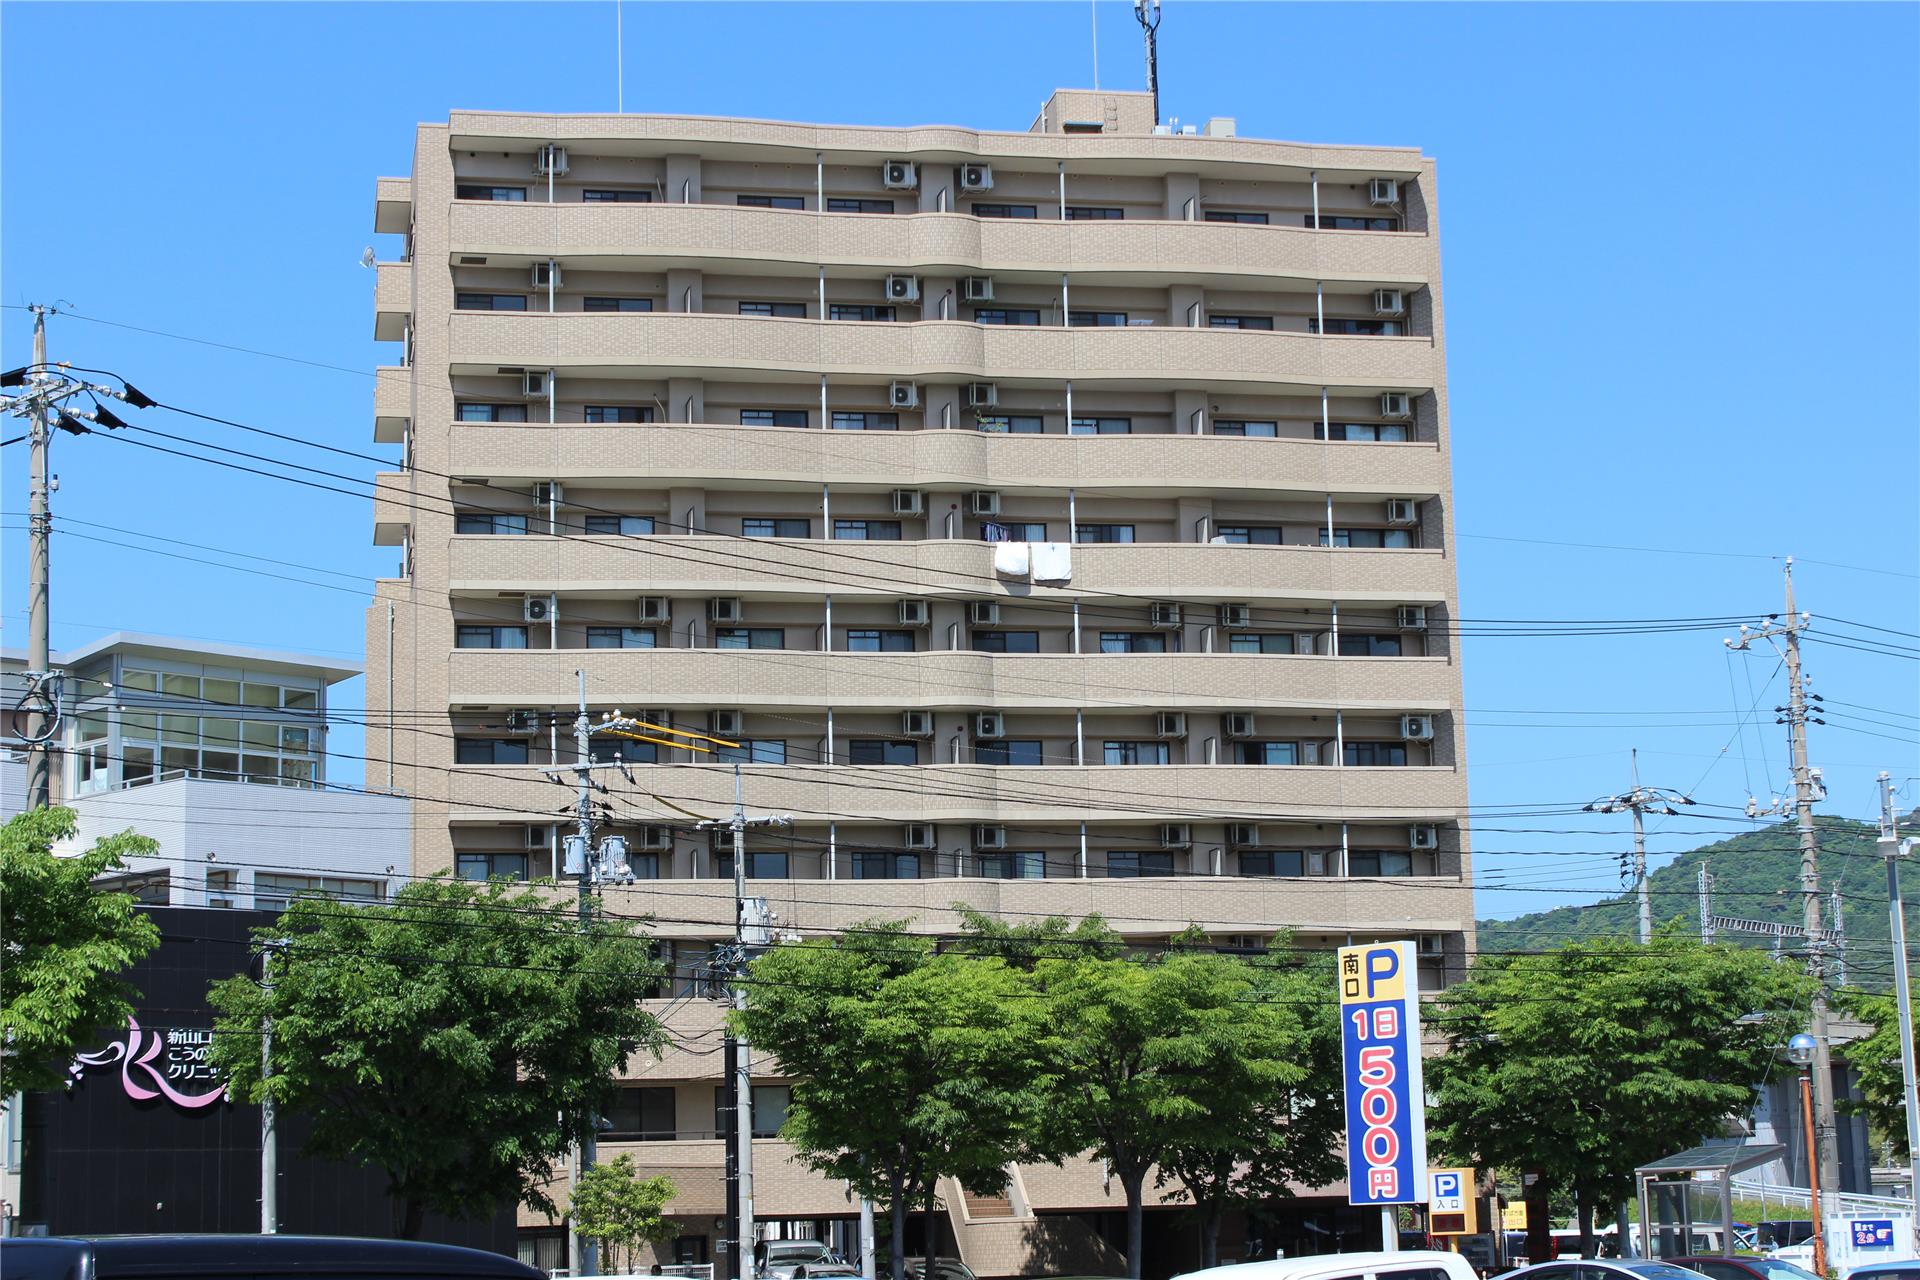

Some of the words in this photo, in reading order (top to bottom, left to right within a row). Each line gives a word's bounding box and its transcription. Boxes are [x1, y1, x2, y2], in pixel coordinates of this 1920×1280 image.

[1343, 953, 1359, 997] 南口
[1366, 949, 1399, 998] P
[167, 1028, 213, 1044] 新山口
[1352, 1007, 1398, 1041] 1日
[1359, 1046, 1399, 1200] 500円
[1437, 1176, 1456, 1196] P
[1437, 1199, 1459, 1209] 入口
